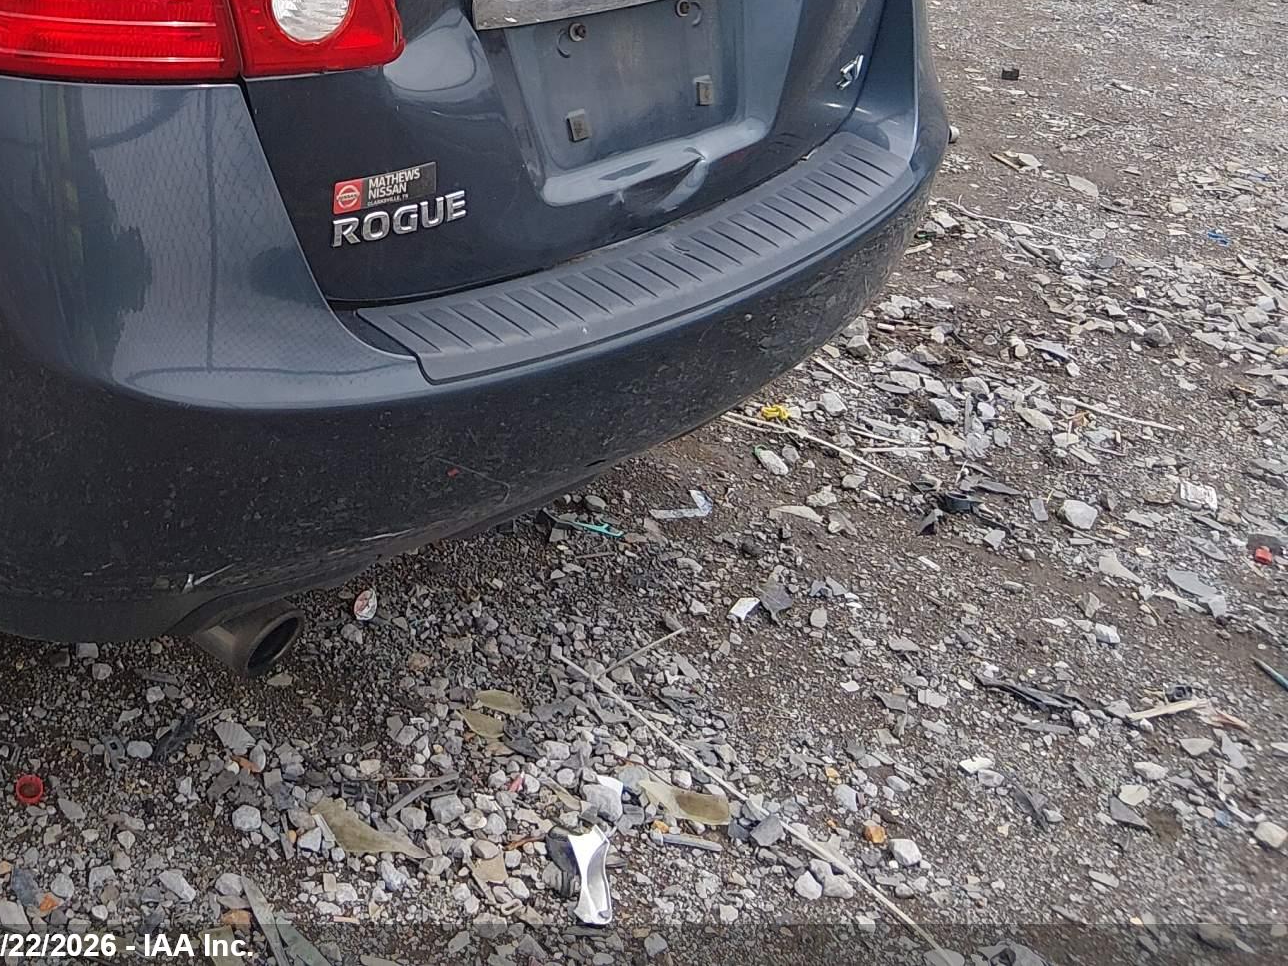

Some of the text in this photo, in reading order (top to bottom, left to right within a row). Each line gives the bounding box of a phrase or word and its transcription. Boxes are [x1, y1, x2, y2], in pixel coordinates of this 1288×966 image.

[836, 54, 864, 90] SV
[368, 183, 407, 200] NISSAN
[369, 168, 421, 189] MATHEWS
[332, 190, 467, 248] ROGUE
